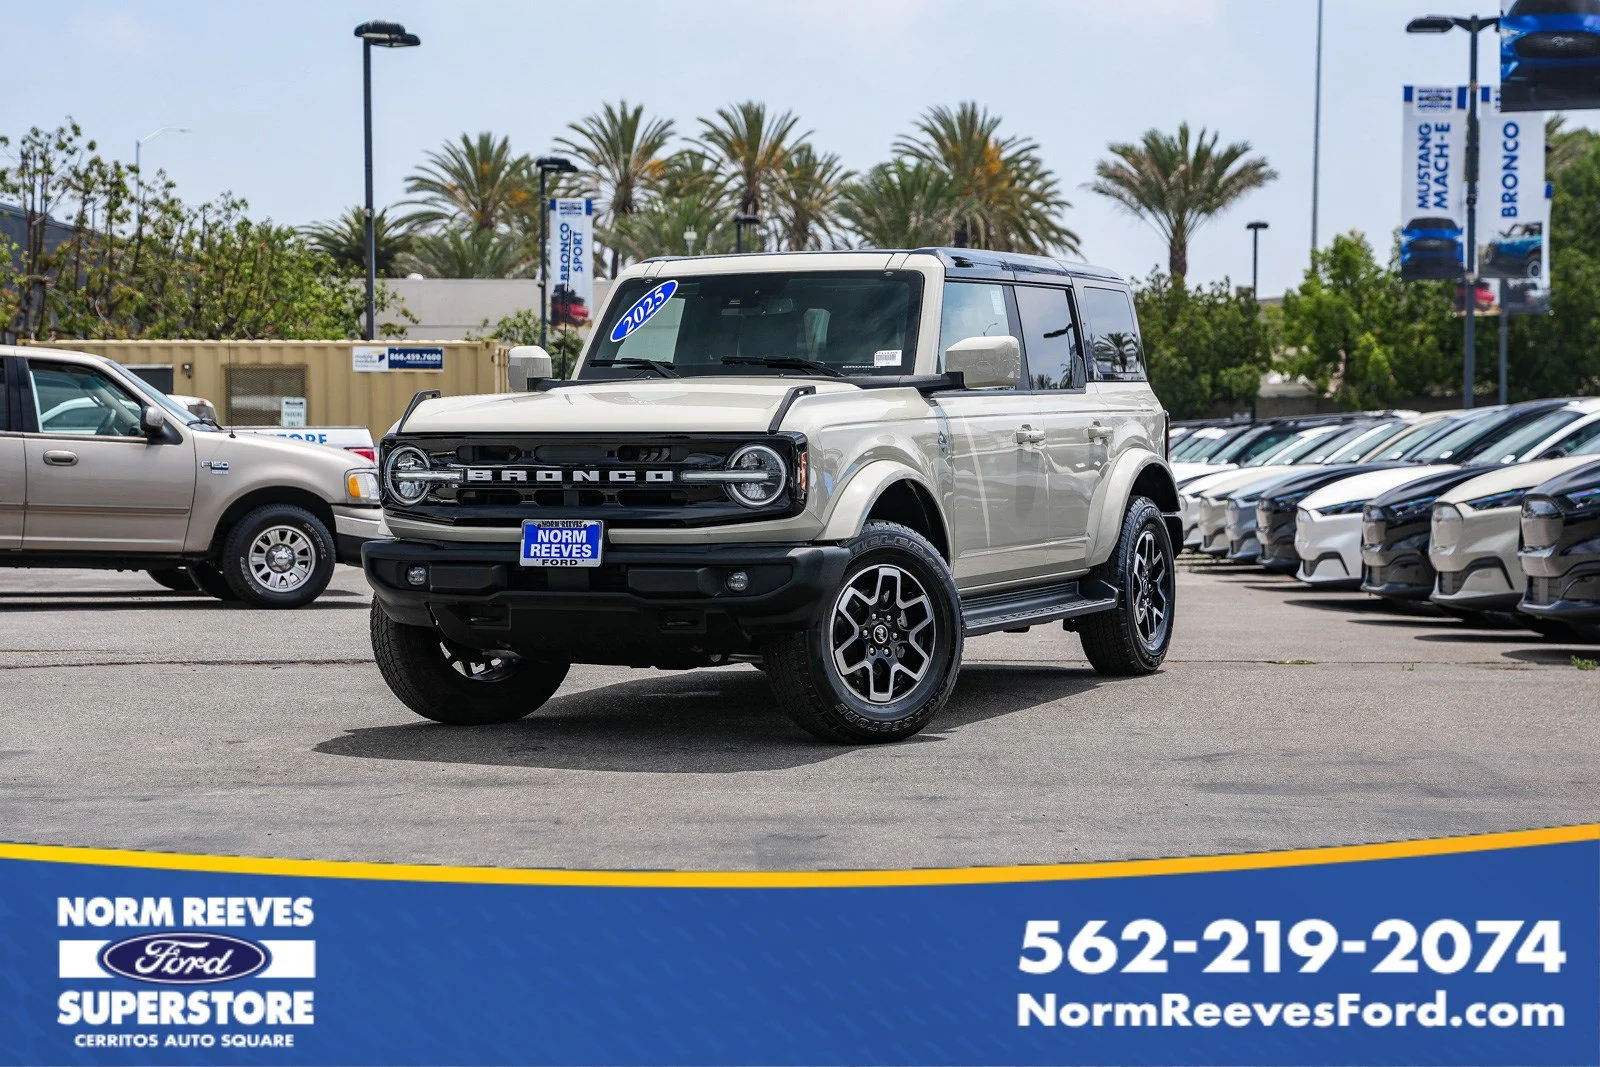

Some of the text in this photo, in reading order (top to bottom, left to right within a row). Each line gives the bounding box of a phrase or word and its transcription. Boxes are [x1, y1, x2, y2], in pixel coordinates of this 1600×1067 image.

[1417, 122, 1432, 210] MUSTANG
[1434, 123, 1451, 210] MACH-E
[1502, 121, 1520, 218] BRONCO
[559, 222, 570, 281] BRONCO
[573, 231, 583, 273] SPORT
[622, 286, 665, 335] 2025
[467, 470, 673, 482] BRONCO
[530, 543, 592, 558] REEVES
[537, 529, 587, 543] NORM
